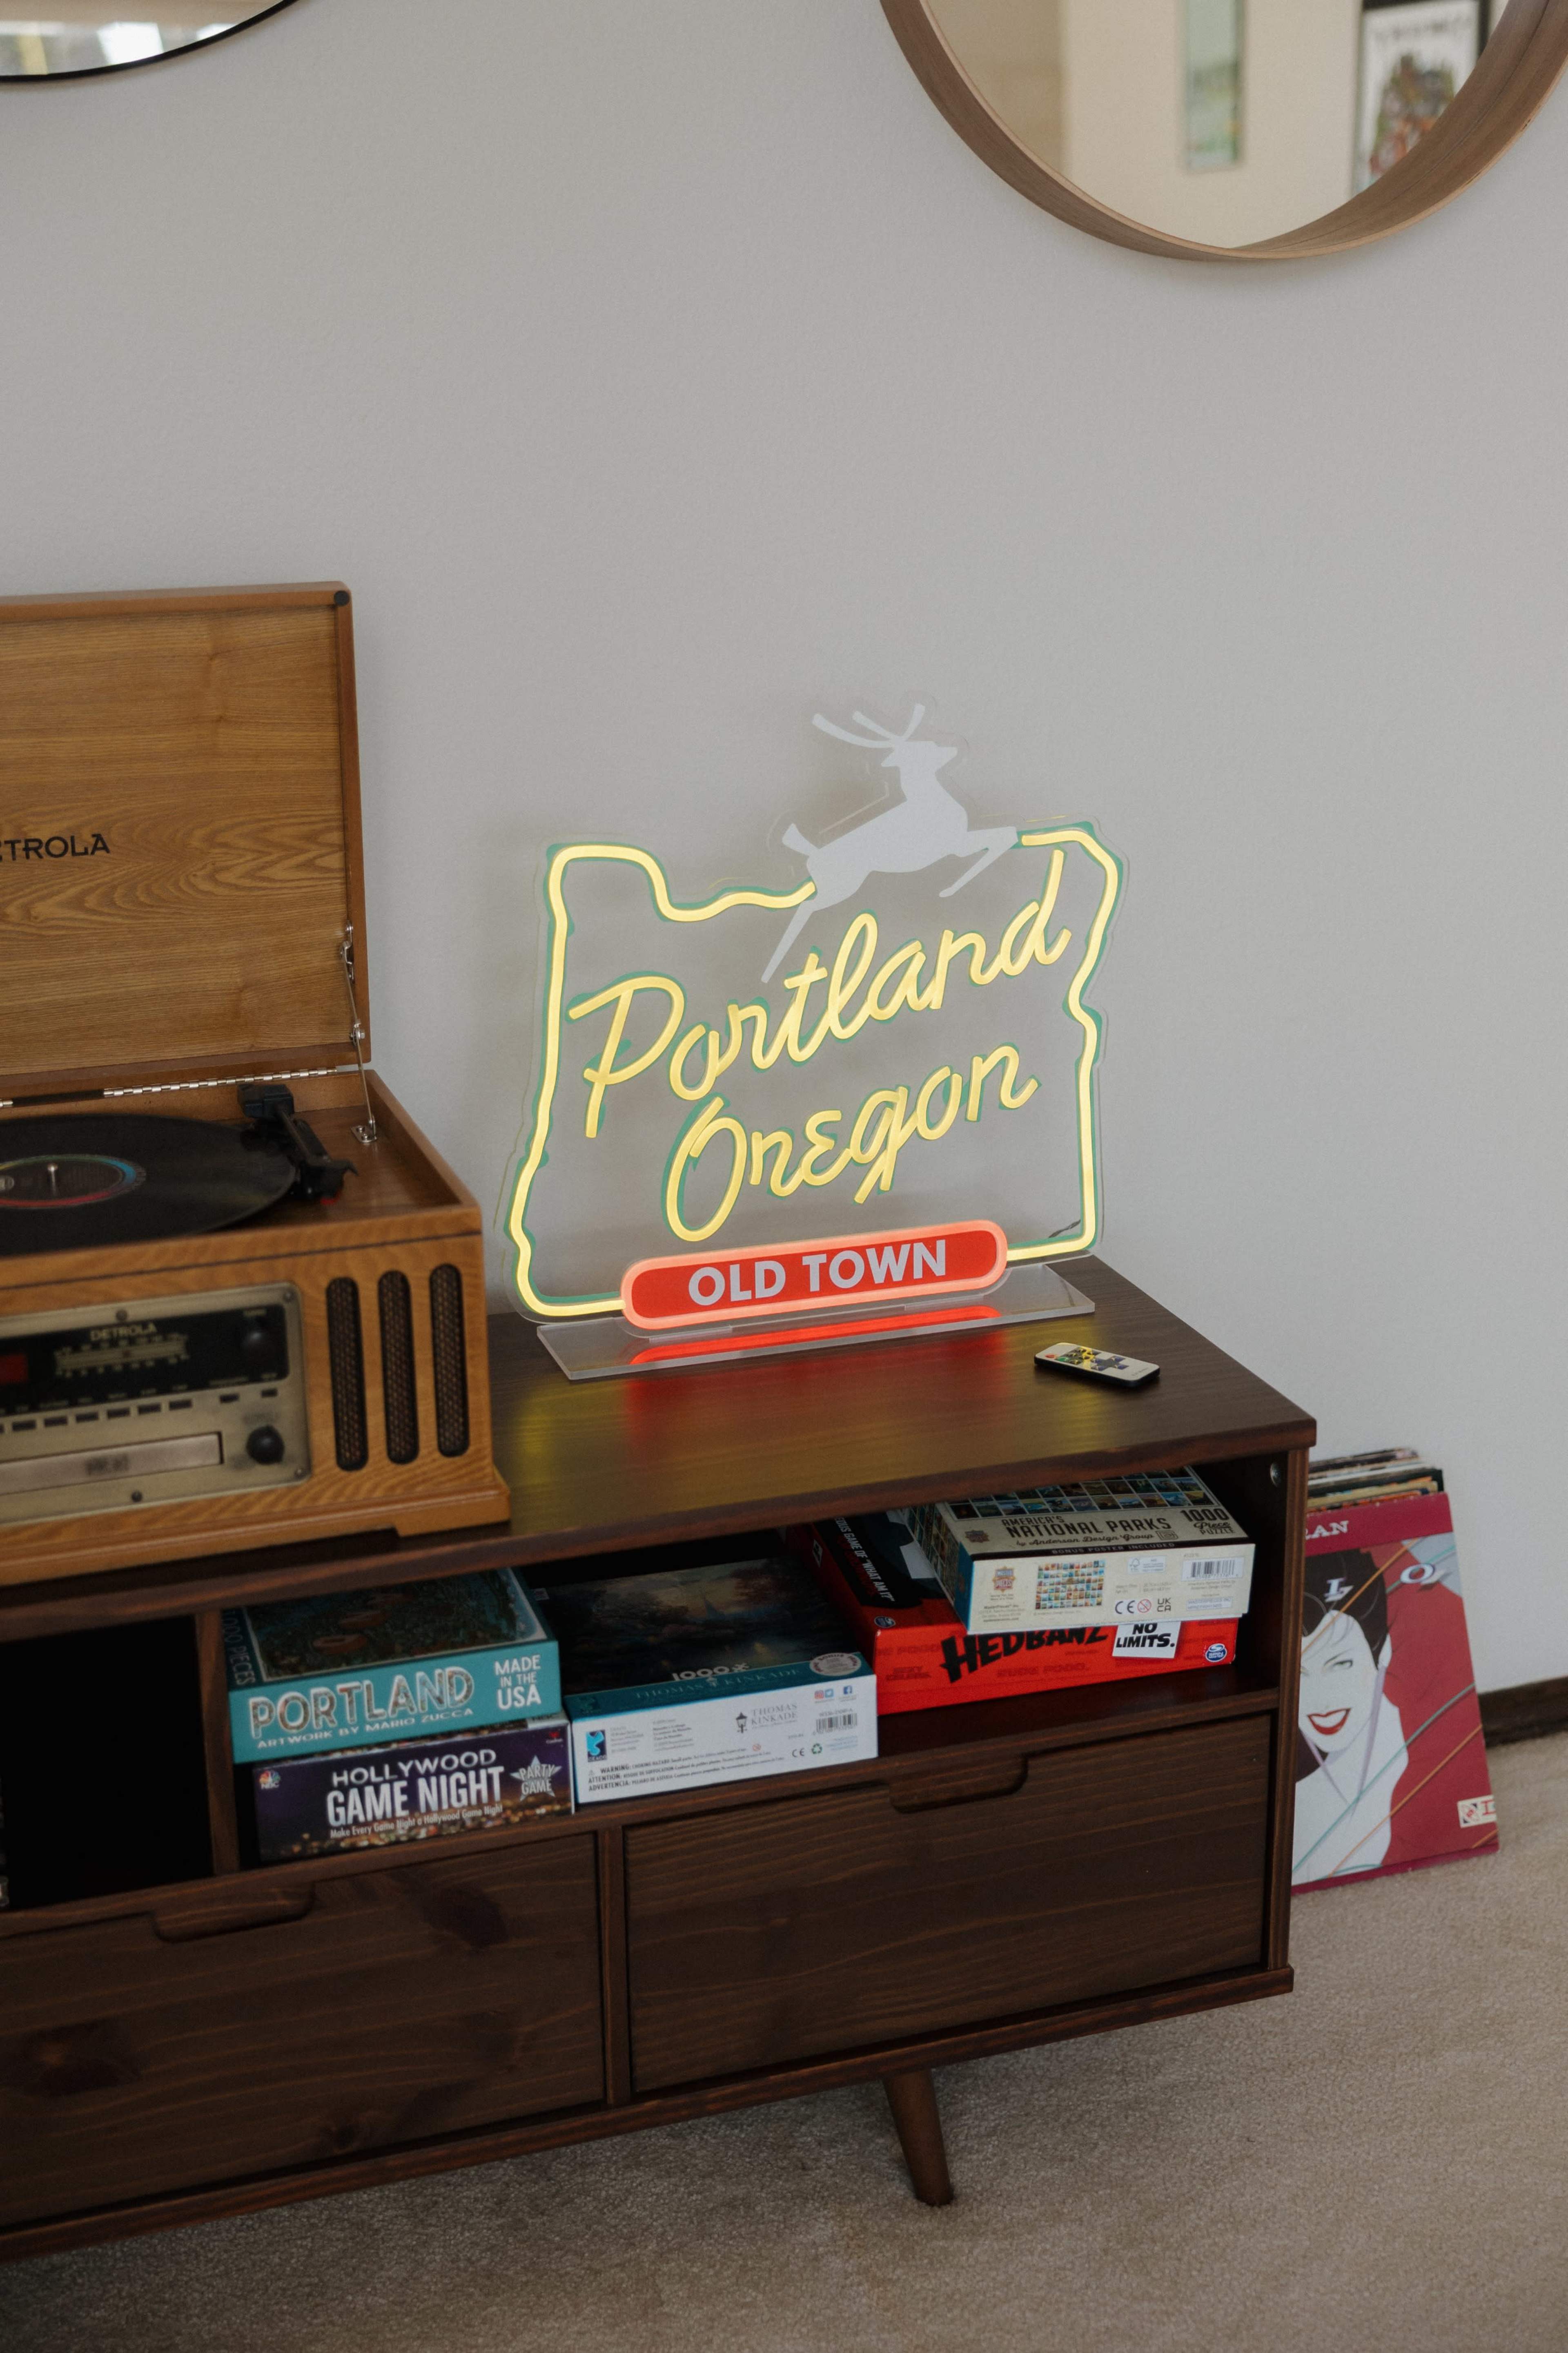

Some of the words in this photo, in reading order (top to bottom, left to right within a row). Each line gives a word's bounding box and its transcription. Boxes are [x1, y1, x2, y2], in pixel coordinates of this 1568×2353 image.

[0, 834, 110, 863] TROLA
[568, 848, 1073, 1138] Portland
[666, 1044, 1040, 1242] Oregon
[688, 1260, 786, 1306] OLD
[802, 1239, 946, 1292] TOWN
[1002, 1516, 1065, 1527] AMERICA'S
[1180, 1508, 1230, 1522] 1000
[1005, 1521, 1104, 1538] NATIONAL
[1105, 1518, 1172, 1532] PARKS
[1194, 1521, 1230, 1530] Piece
[843, 1532, 863, 1550] GAME
[854, 1550, 868, 1559] OF
[1029, 1537, 1080, 1546] Anderson
[1082, 1534, 1119, 1543] Design
[1120, 1532, 1153, 1541] Group
[1132, 1623, 1157, 1634] NO
[1116, 1633, 1176, 1648] LIMITS.
[227, 1644, 256, 1686] PIECES
[494, 1655, 541, 1676] MADE
[672, 1666, 730, 1681] 1000
[500, 1677, 512, 1688] IN
[516, 1671, 537, 1685] THE
[248, 1666, 475, 1739] PORTLAND
[496, 1684, 542, 1711] USA
[751, 1712, 797, 1725] KINKADE
[752, 1703, 797, 1717] THOMAS
[257, 1729, 334, 1749] ARTWORK
[339, 1726, 360, 1737] BY
[365, 1717, 416, 1731] MARIO
[421, 1708, 474, 1723] ZUCCA
[332, 1748, 497, 1788] HOLLYWOOD
[518, 1763, 557, 1780] PARTY
[327, 1780, 410, 1828] GAME
[417, 1765, 505, 1814] NIGHT
[521, 1779, 552, 1795] GAME
[330, 1828, 350, 1839] Make
[352, 1825, 372, 1837] Every
[374, 1822, 394, 1833] Game
[396, 1818, 415, 1830] Night
[424, 1811, 460, 1826] Hollywood
[462, 1808, 483, 1818] Game
[484, 1804, 503, 1815] Night
